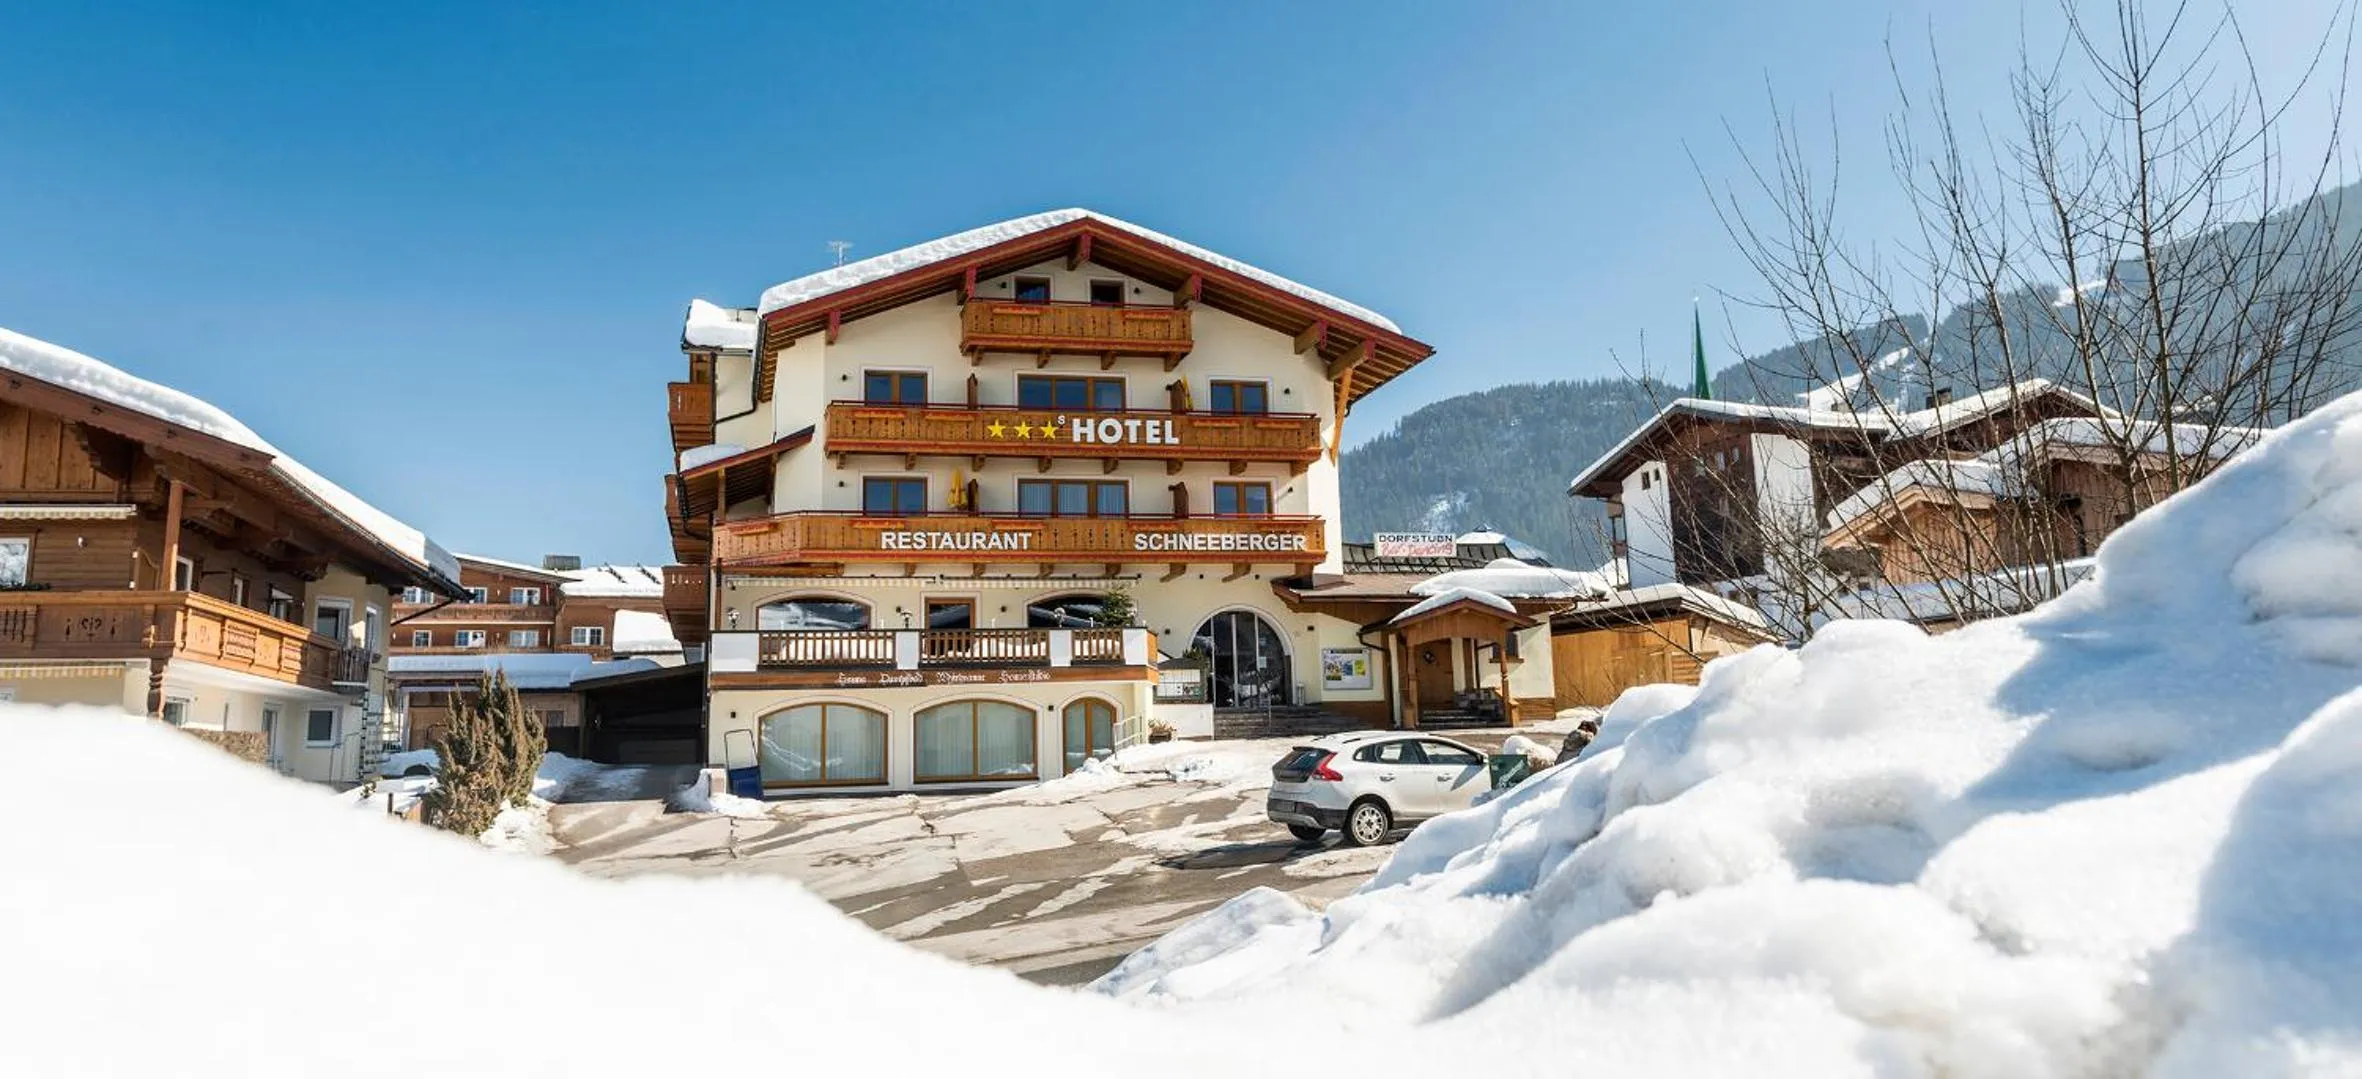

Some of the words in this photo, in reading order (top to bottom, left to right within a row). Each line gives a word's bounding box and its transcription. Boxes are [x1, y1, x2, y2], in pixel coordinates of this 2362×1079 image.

[1072, 417, 1180, 444] HOTEL
[881, 531, 1032, 550] RESTAURANT
[1134, 532, 1308, 551] SCHNEEBERGER
